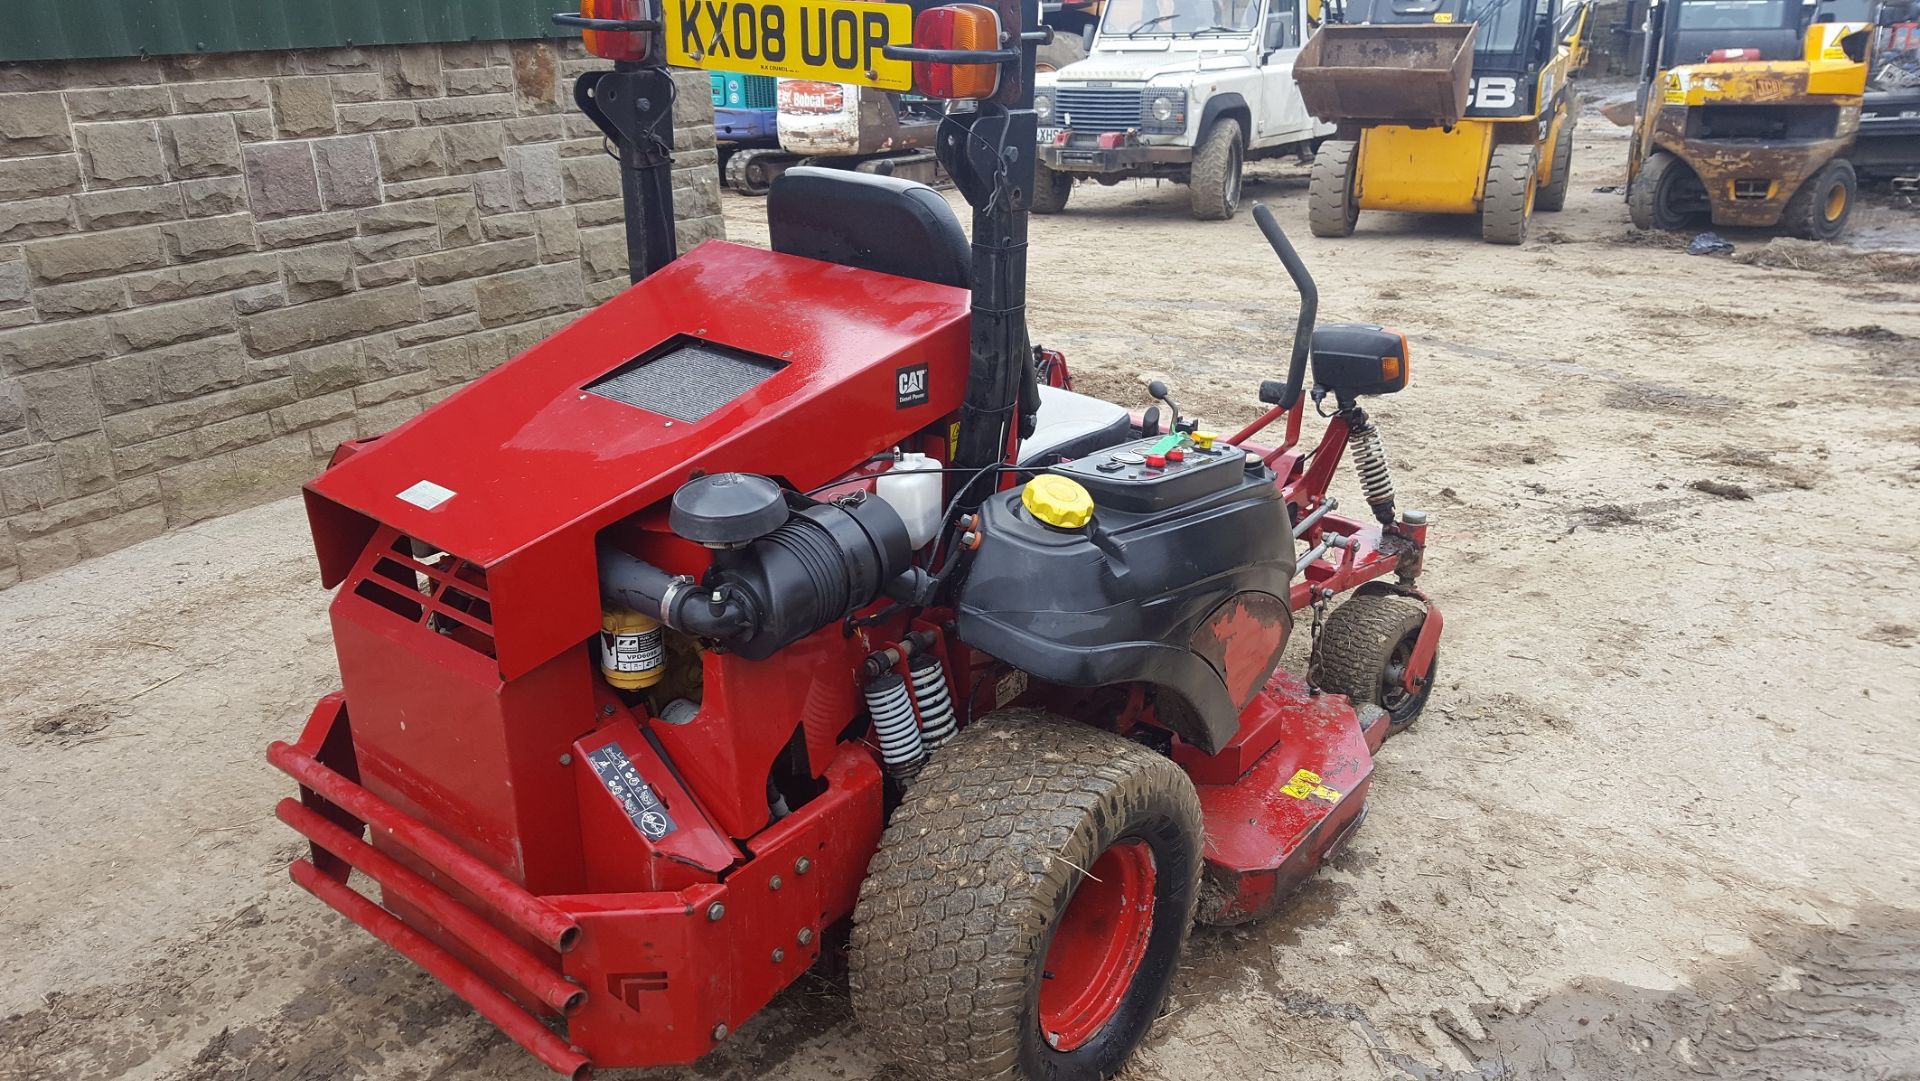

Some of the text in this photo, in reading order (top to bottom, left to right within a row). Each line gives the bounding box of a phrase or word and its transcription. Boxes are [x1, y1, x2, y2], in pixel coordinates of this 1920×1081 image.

[680, 0, 889, 71] KX08 UOP
[793, 91, 825, 107] Bobcat
[899, 369, 925, 394] CAT
